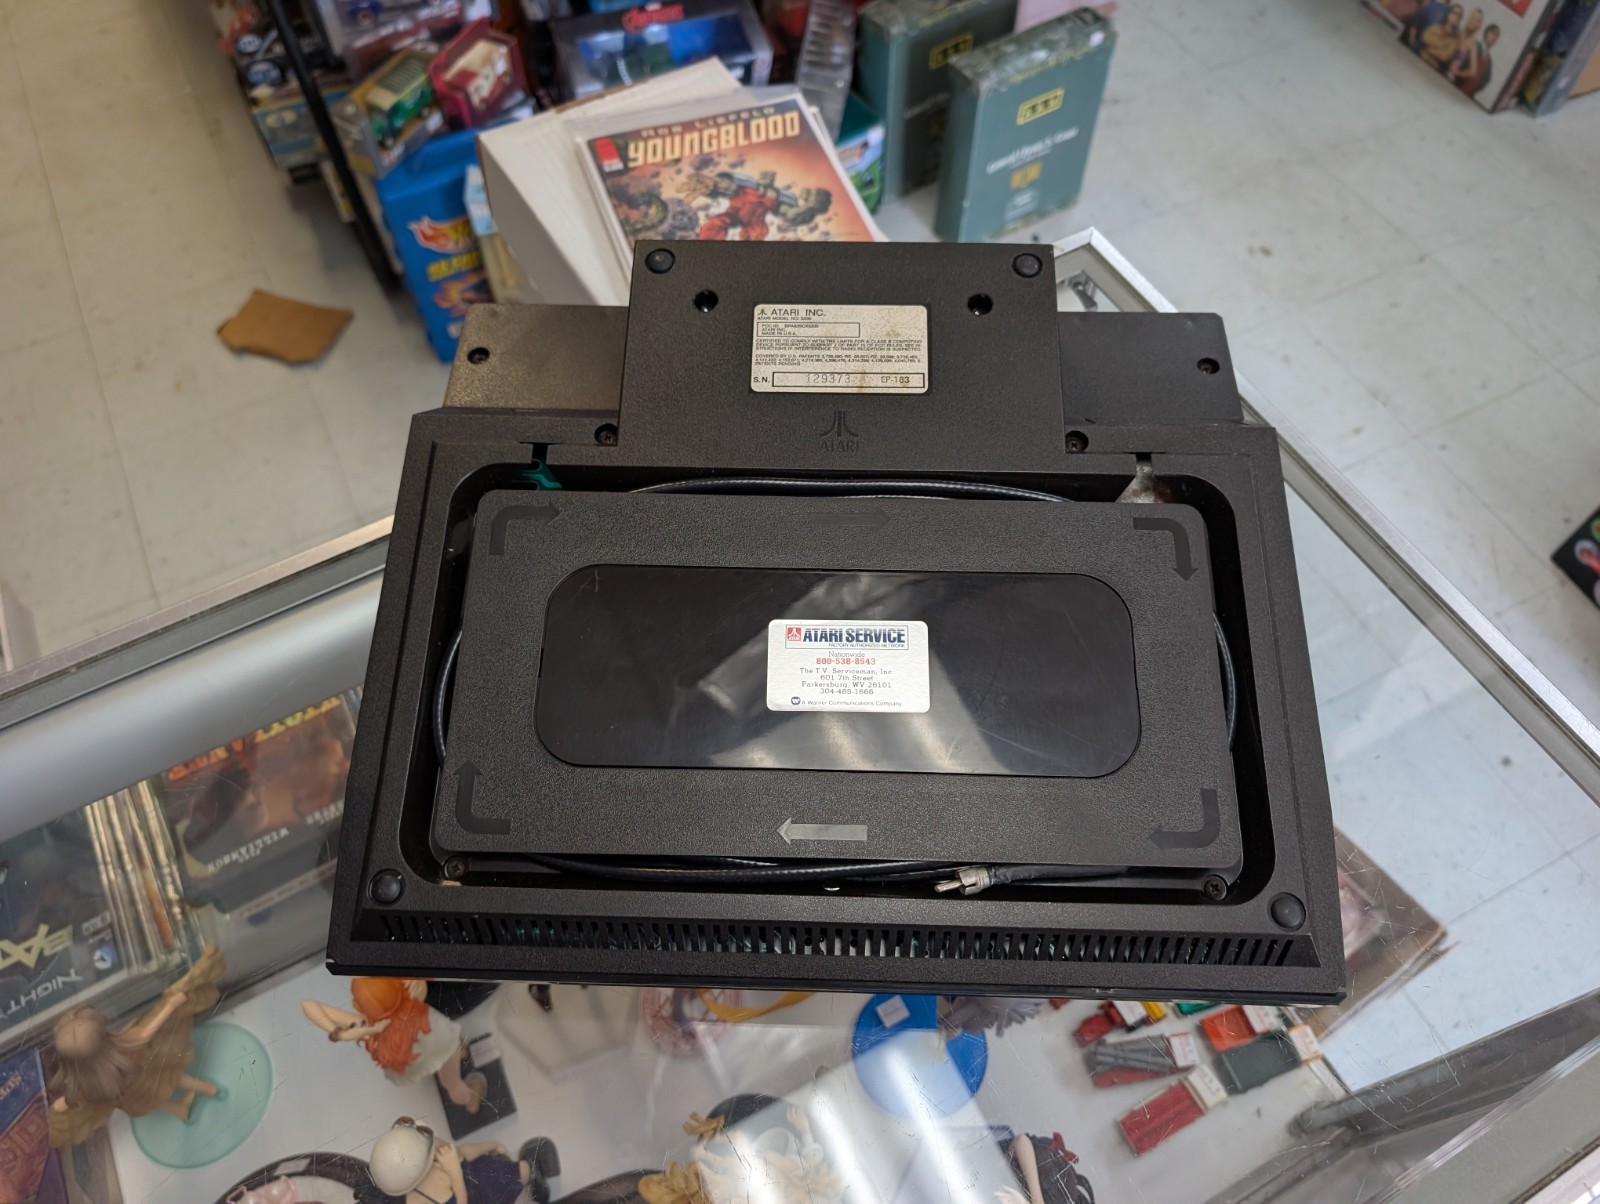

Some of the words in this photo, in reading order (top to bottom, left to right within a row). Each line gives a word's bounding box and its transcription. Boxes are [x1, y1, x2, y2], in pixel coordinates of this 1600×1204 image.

[770, 308, 799, 316] ATARI
[805, 308, 827, 317] INC.
[820, 440, 859, 453] ATARI
[803, 628, 843, 643] ATARI
[845, 628, 905, 643] SERVICE
